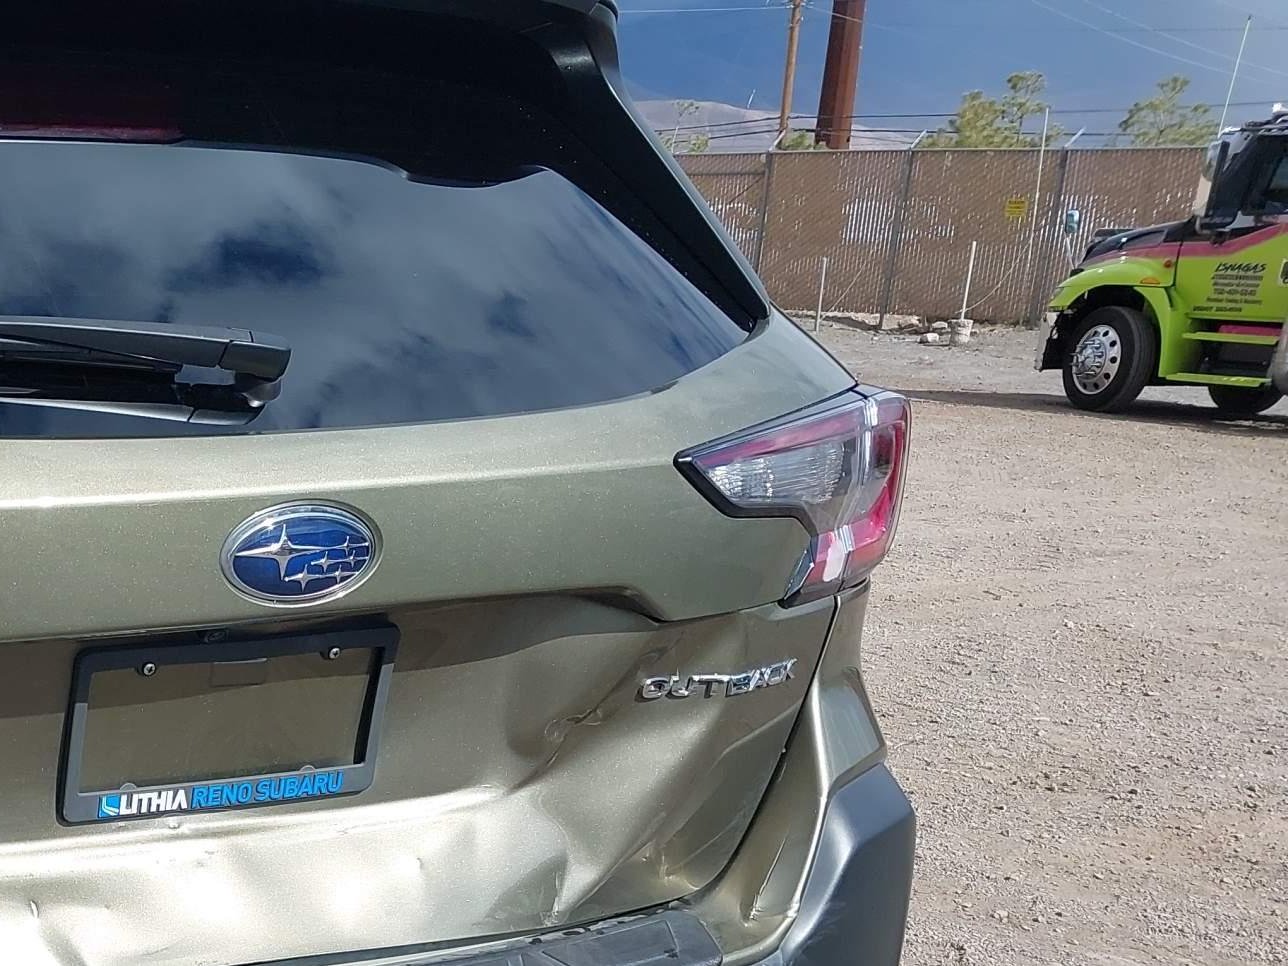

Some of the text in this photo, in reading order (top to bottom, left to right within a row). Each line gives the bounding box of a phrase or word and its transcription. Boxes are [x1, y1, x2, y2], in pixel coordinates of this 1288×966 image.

[641, 657, 799, 699] OUTBACK
[120, 770, 345, 815] LITHIA RENO SUBARU
